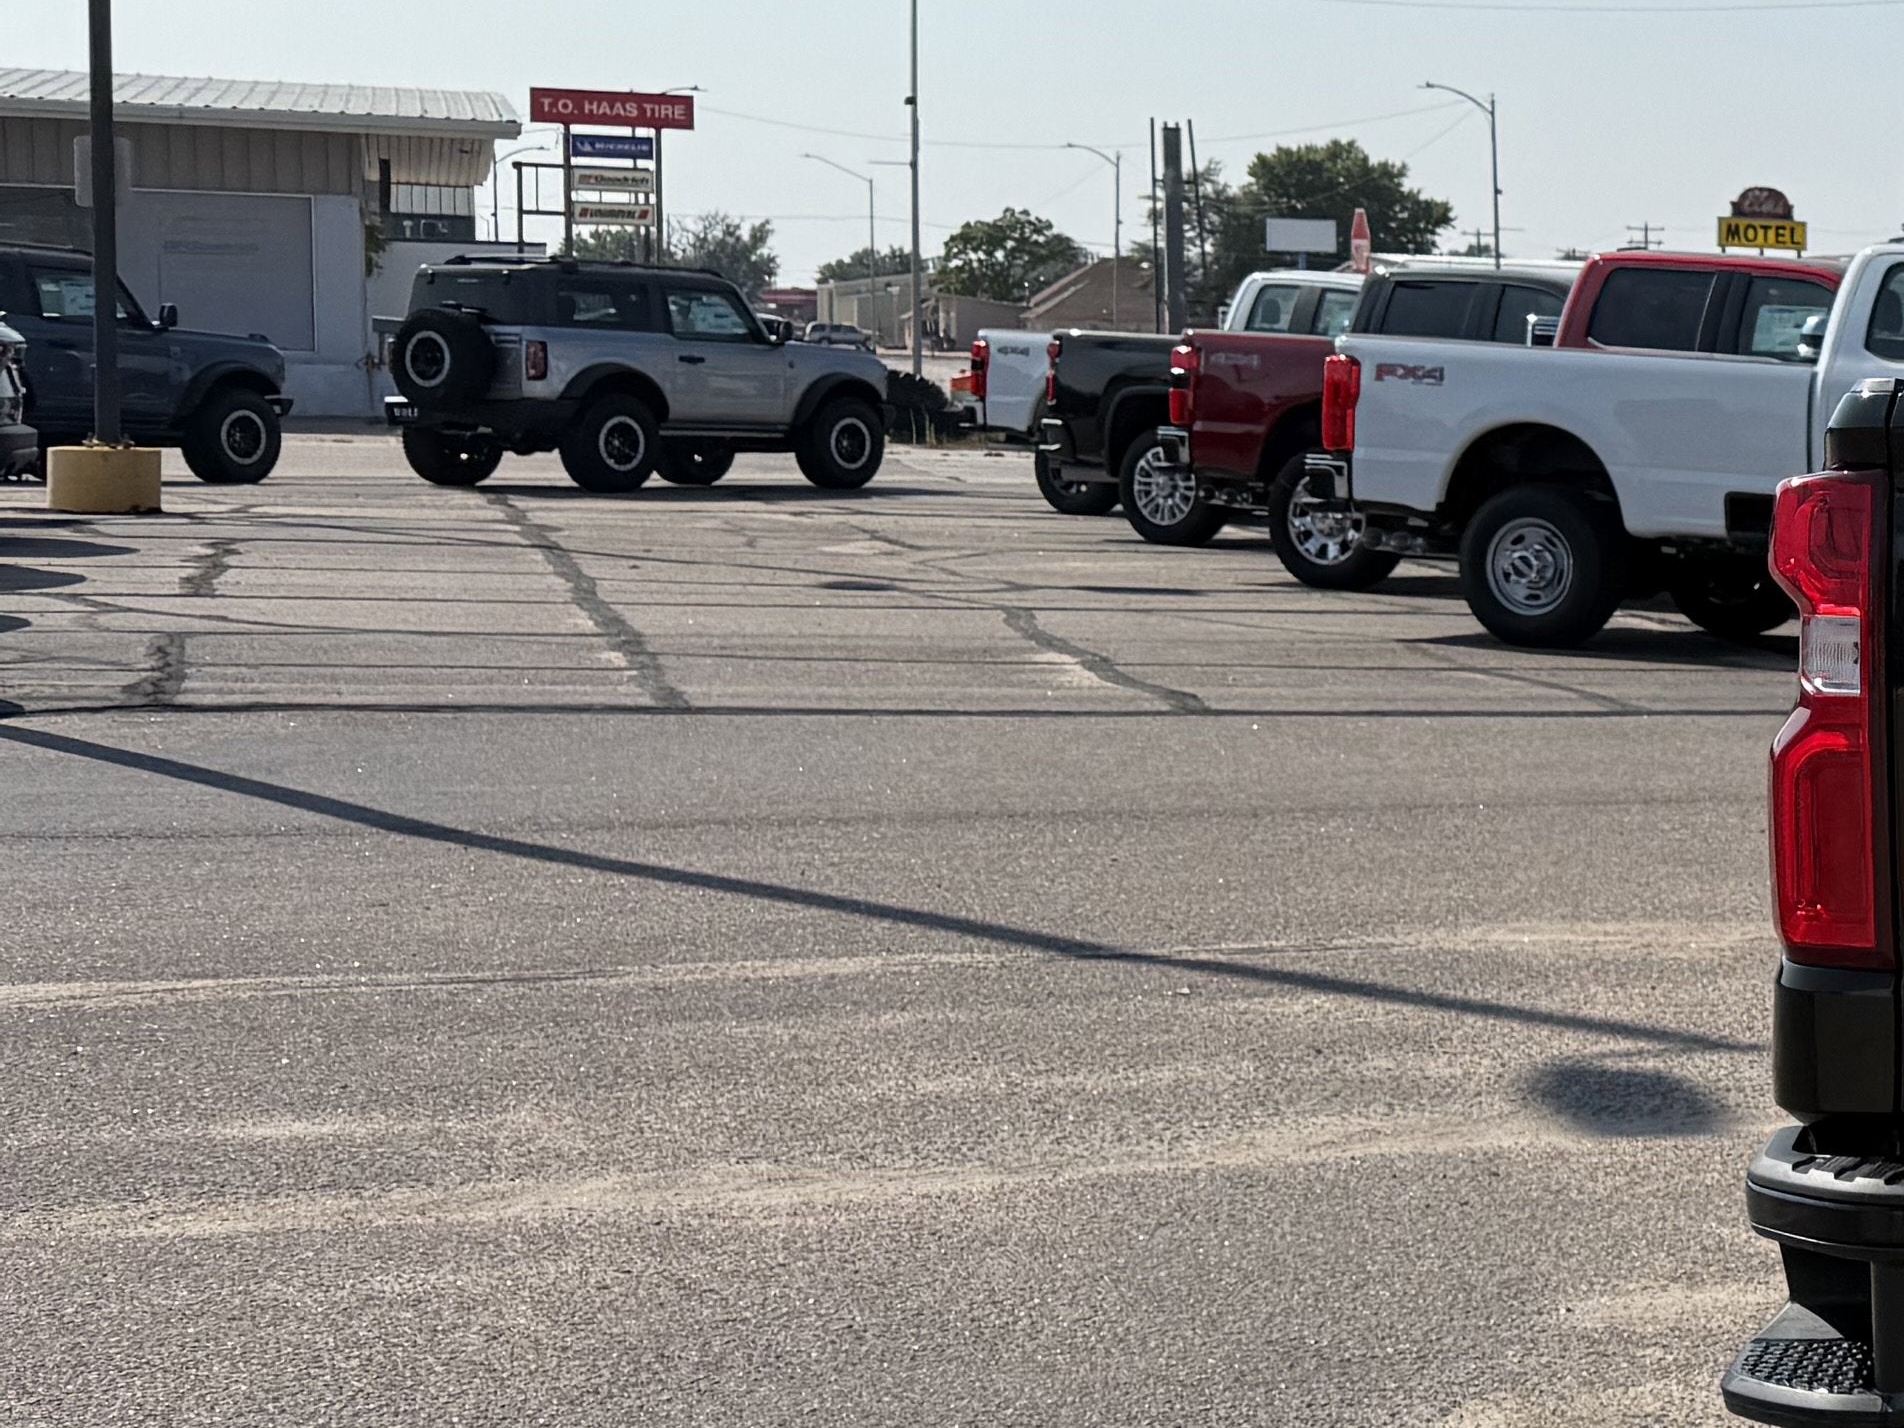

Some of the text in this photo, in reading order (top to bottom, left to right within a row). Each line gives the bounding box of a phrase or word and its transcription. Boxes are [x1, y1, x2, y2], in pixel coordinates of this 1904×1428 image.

[540, 98, 687, 120] T.O. HAAS TIRE
[1725, 223, 1802, 246] MOTEL
